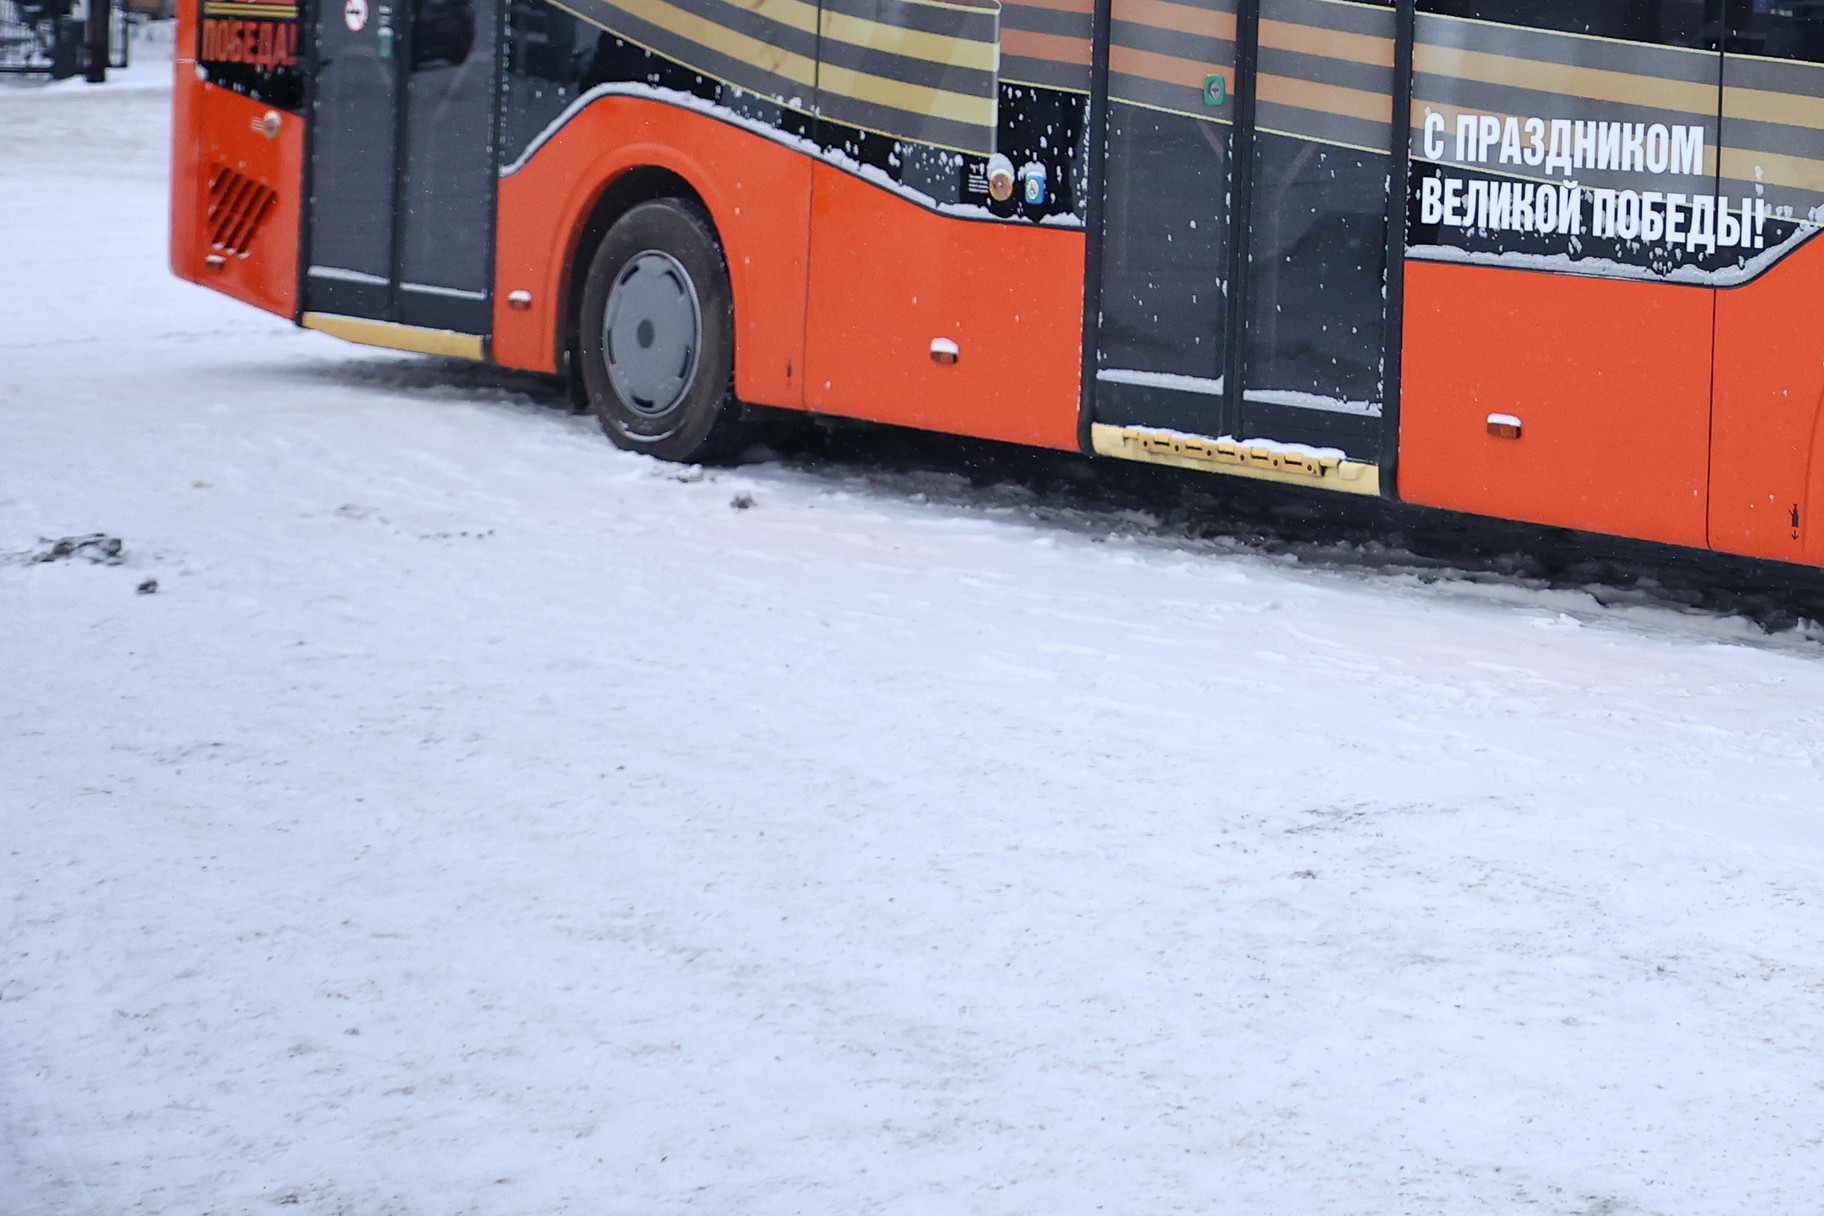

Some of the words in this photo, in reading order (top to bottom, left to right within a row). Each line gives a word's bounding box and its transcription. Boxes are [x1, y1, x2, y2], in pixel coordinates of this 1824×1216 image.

[202, 17, 298, 72] ПОБЕДА!
[1423, 112, 1445, 160] С
[1455, 114, 1705, 176] ПРАЗДНИКОМ
[1420, 176, 1581, 235] ВЕЛИКОЙ
[1592, 188, 1765, 255] ПОБЕДЫ!
